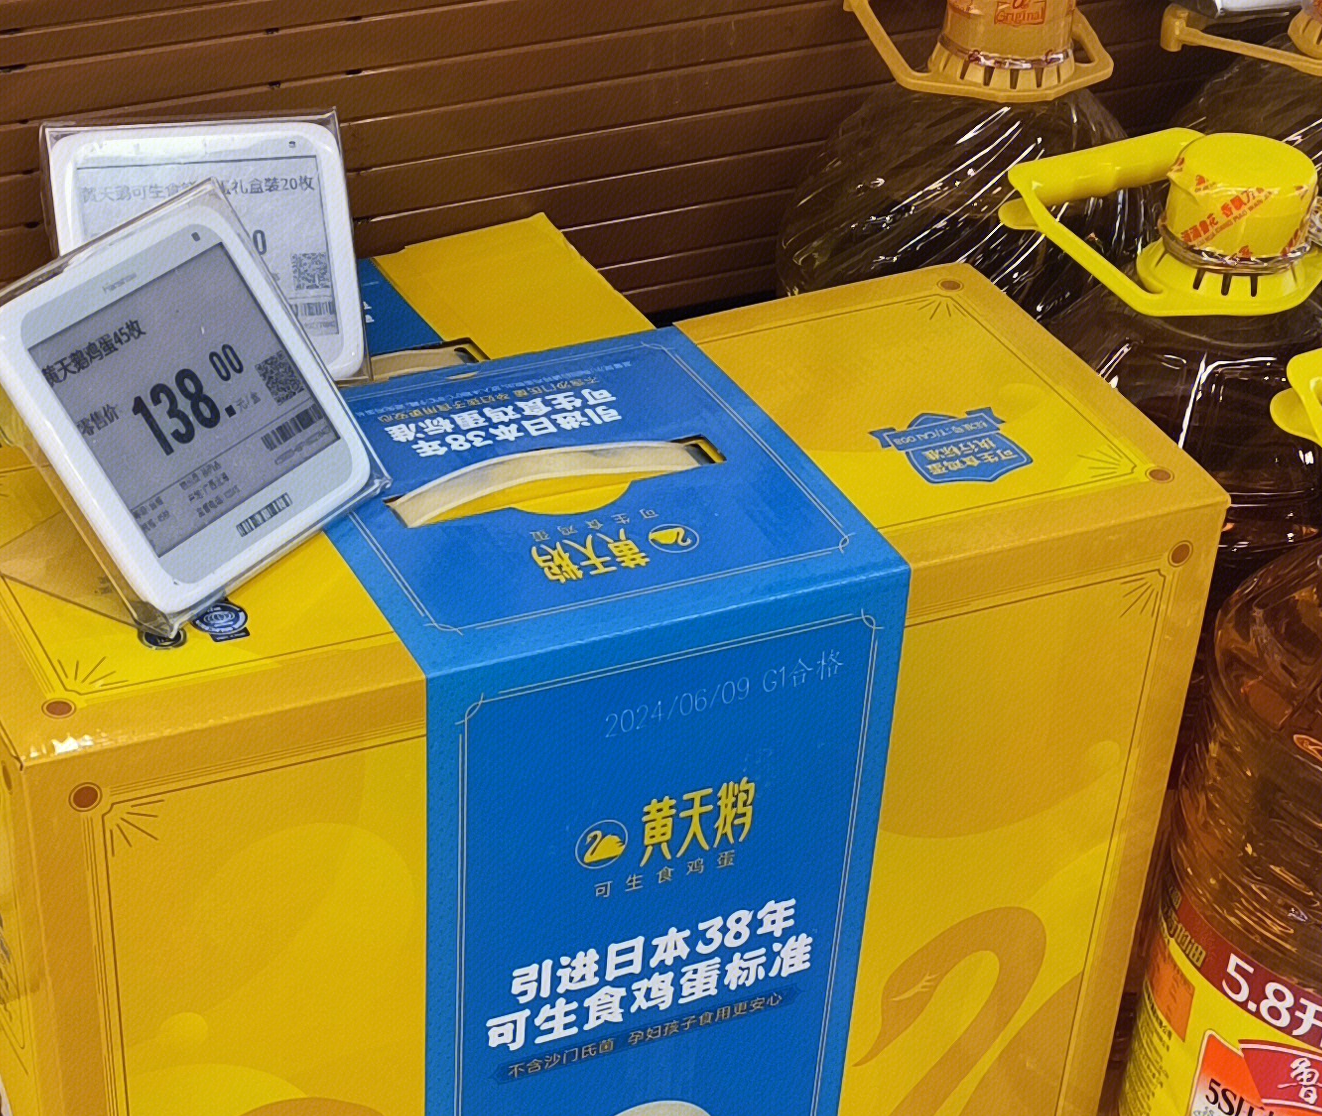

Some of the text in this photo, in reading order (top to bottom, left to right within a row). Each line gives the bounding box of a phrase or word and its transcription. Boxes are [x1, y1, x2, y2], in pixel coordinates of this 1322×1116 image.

[40, 318, 147, 388] 黄天鹅鸡蛋45枚
[385, 387, 616, 445] 可生食鸡蛋标准
[412, 405, 622, 458] 引进日本38年
[529, 507, 659, 542] 可生食鸡蛋
[532, 528, 650, 585] 黄天鹅
[603, 649, 846, 741] 2024/06/09 G1合格
[638, 775, 757, 868] 黄天鹅
[594, 849, 738, 899] 可生食鸡蛋
[509, 897, 797, 1005] 引进日本38年
[484, 931, 814, 1052] 可生食鸡蛋标准
[507, 990, 784, 1079] 不含沙门氏菌 孕妇孩子食用更安心
